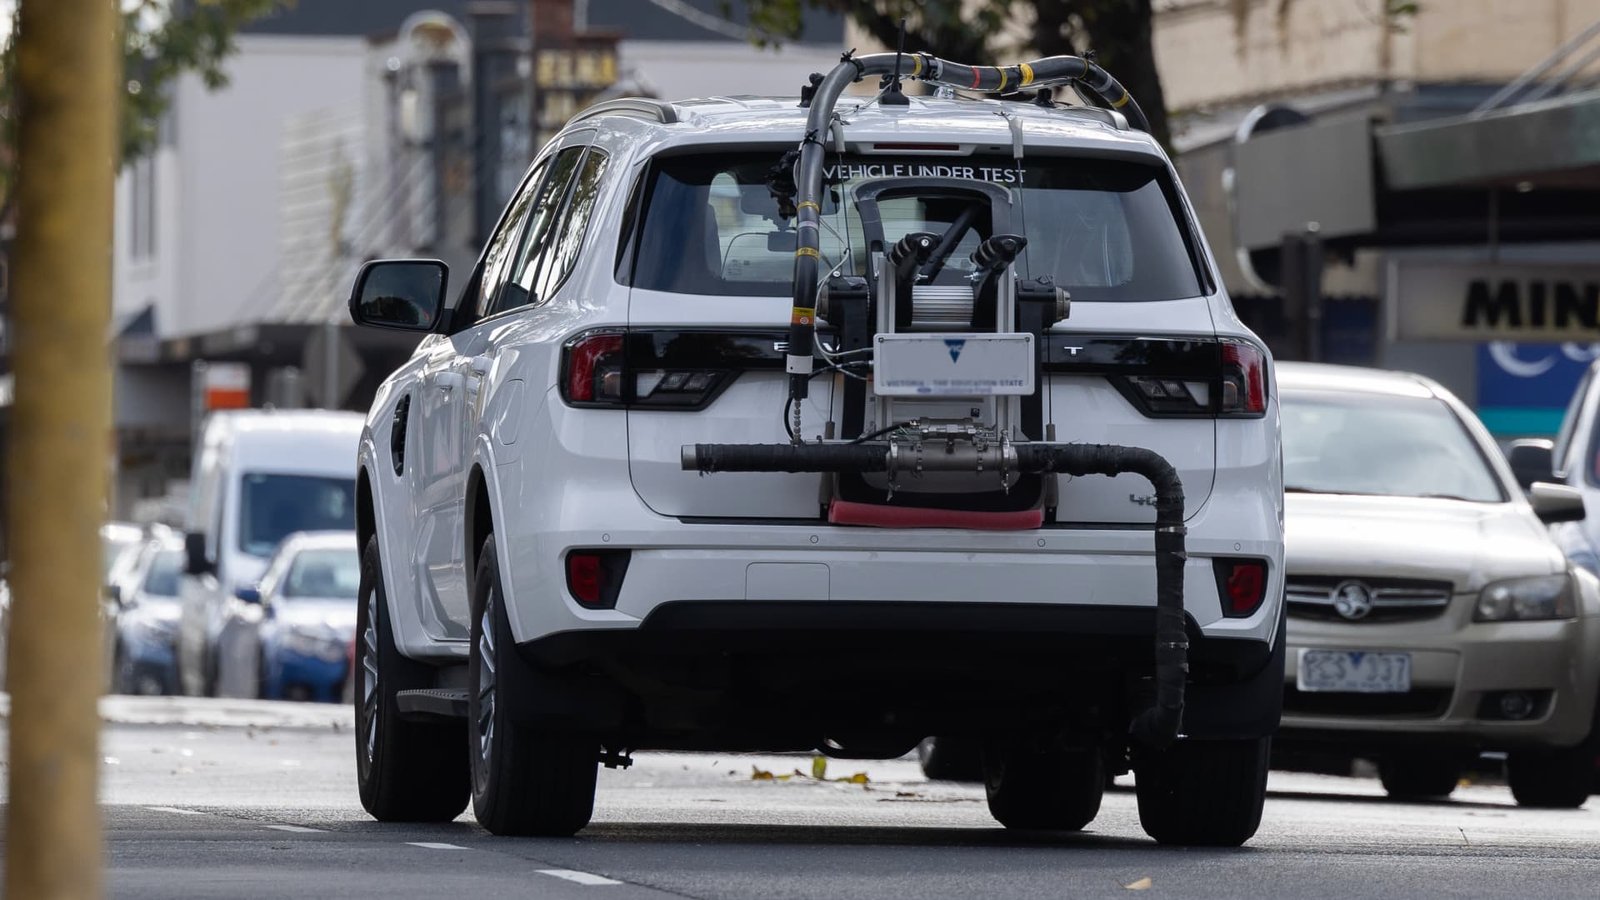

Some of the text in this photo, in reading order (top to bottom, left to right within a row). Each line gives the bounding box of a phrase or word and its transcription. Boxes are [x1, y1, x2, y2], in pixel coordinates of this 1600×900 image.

[822, 164, 1027, 183] VEHICLE UNDER TEST
